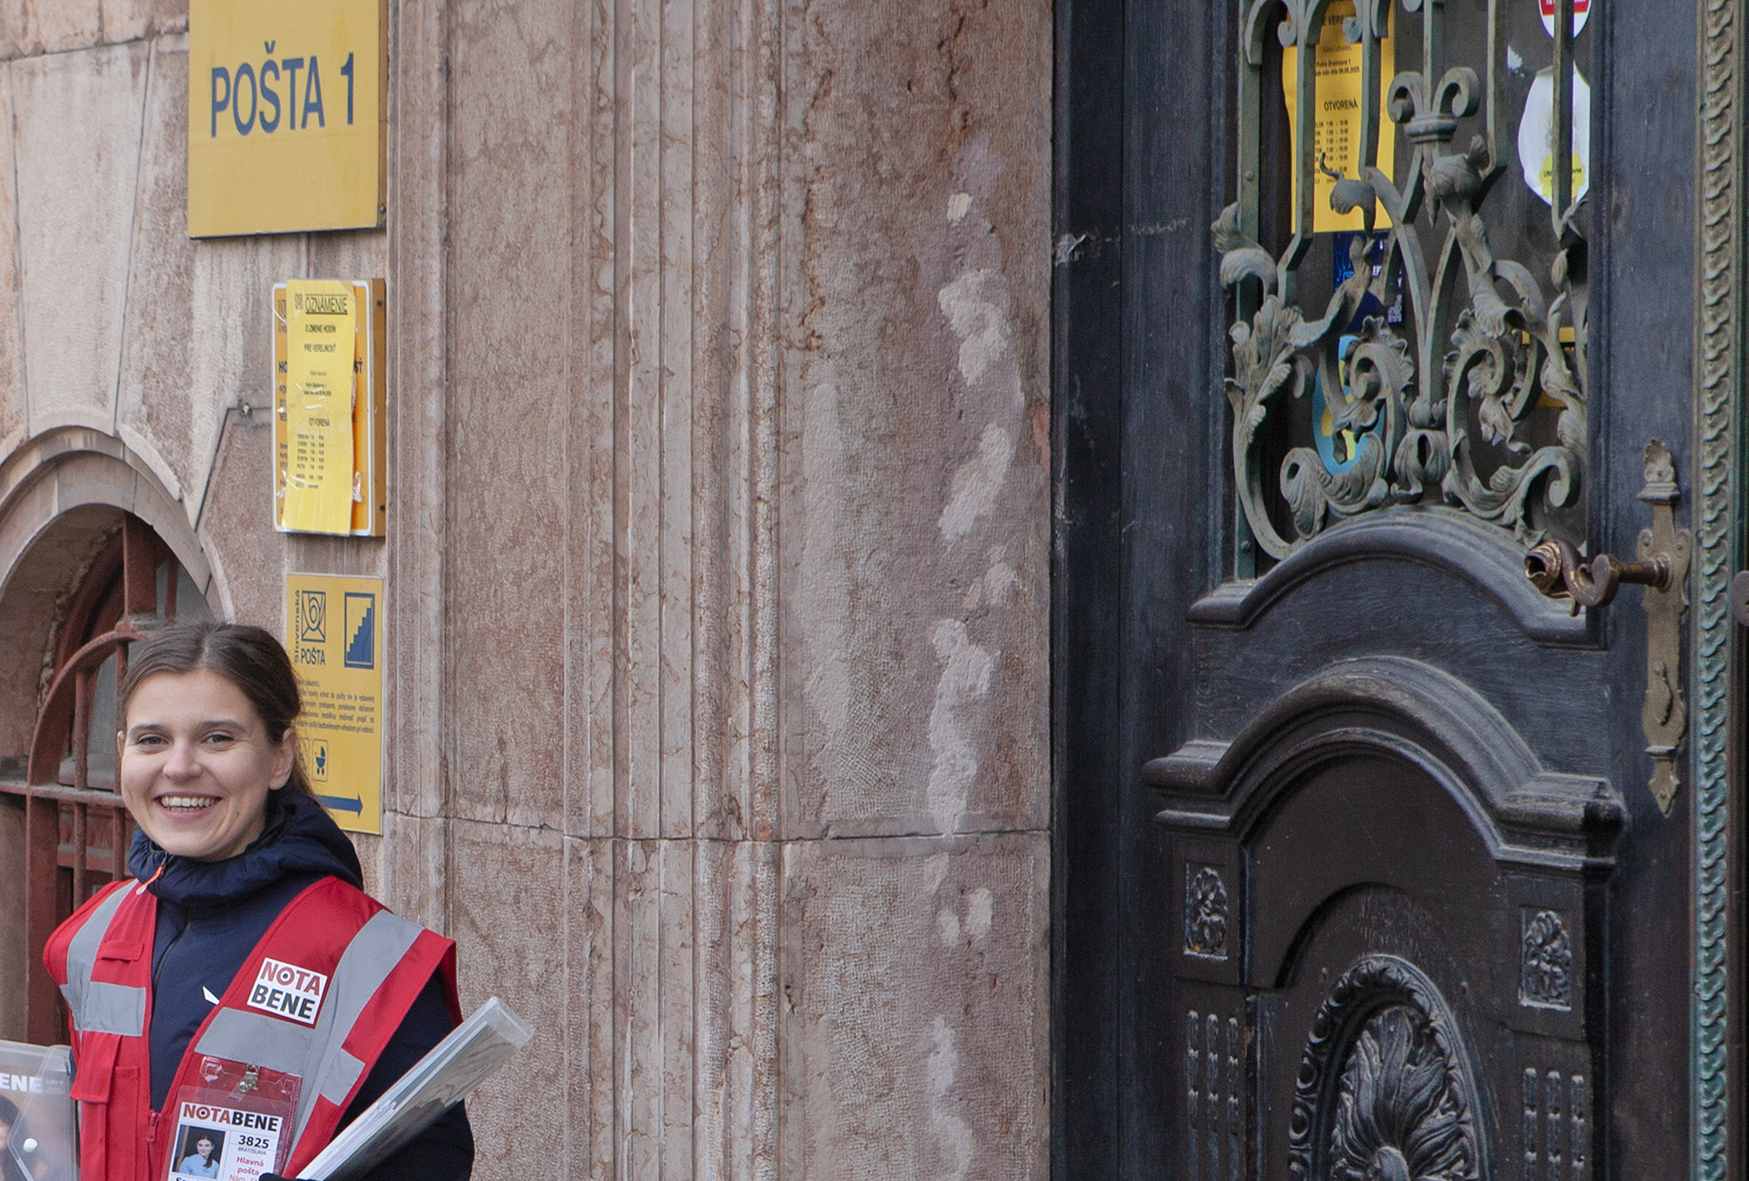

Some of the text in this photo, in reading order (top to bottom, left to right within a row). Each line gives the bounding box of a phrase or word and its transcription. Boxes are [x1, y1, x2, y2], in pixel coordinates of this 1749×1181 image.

[211, 40, 354, 138] POŠTA 1
[1324, 97, 1358, 111] OTVORENÁ
[305, 294, 348, 313] OZNÁMENIE
[301, 647, 326, 666] POŠTA
[260, 961, 321, 996] NOTA
[251, 984, 316, 1020] BENE
[183, 1104, 279, 1132] NOTABENE
[238, 1135, 270, 1149] 3825
[236, 1156, 264, 1167] Hlavná
[237, 1167, 259, 1176] pošta
